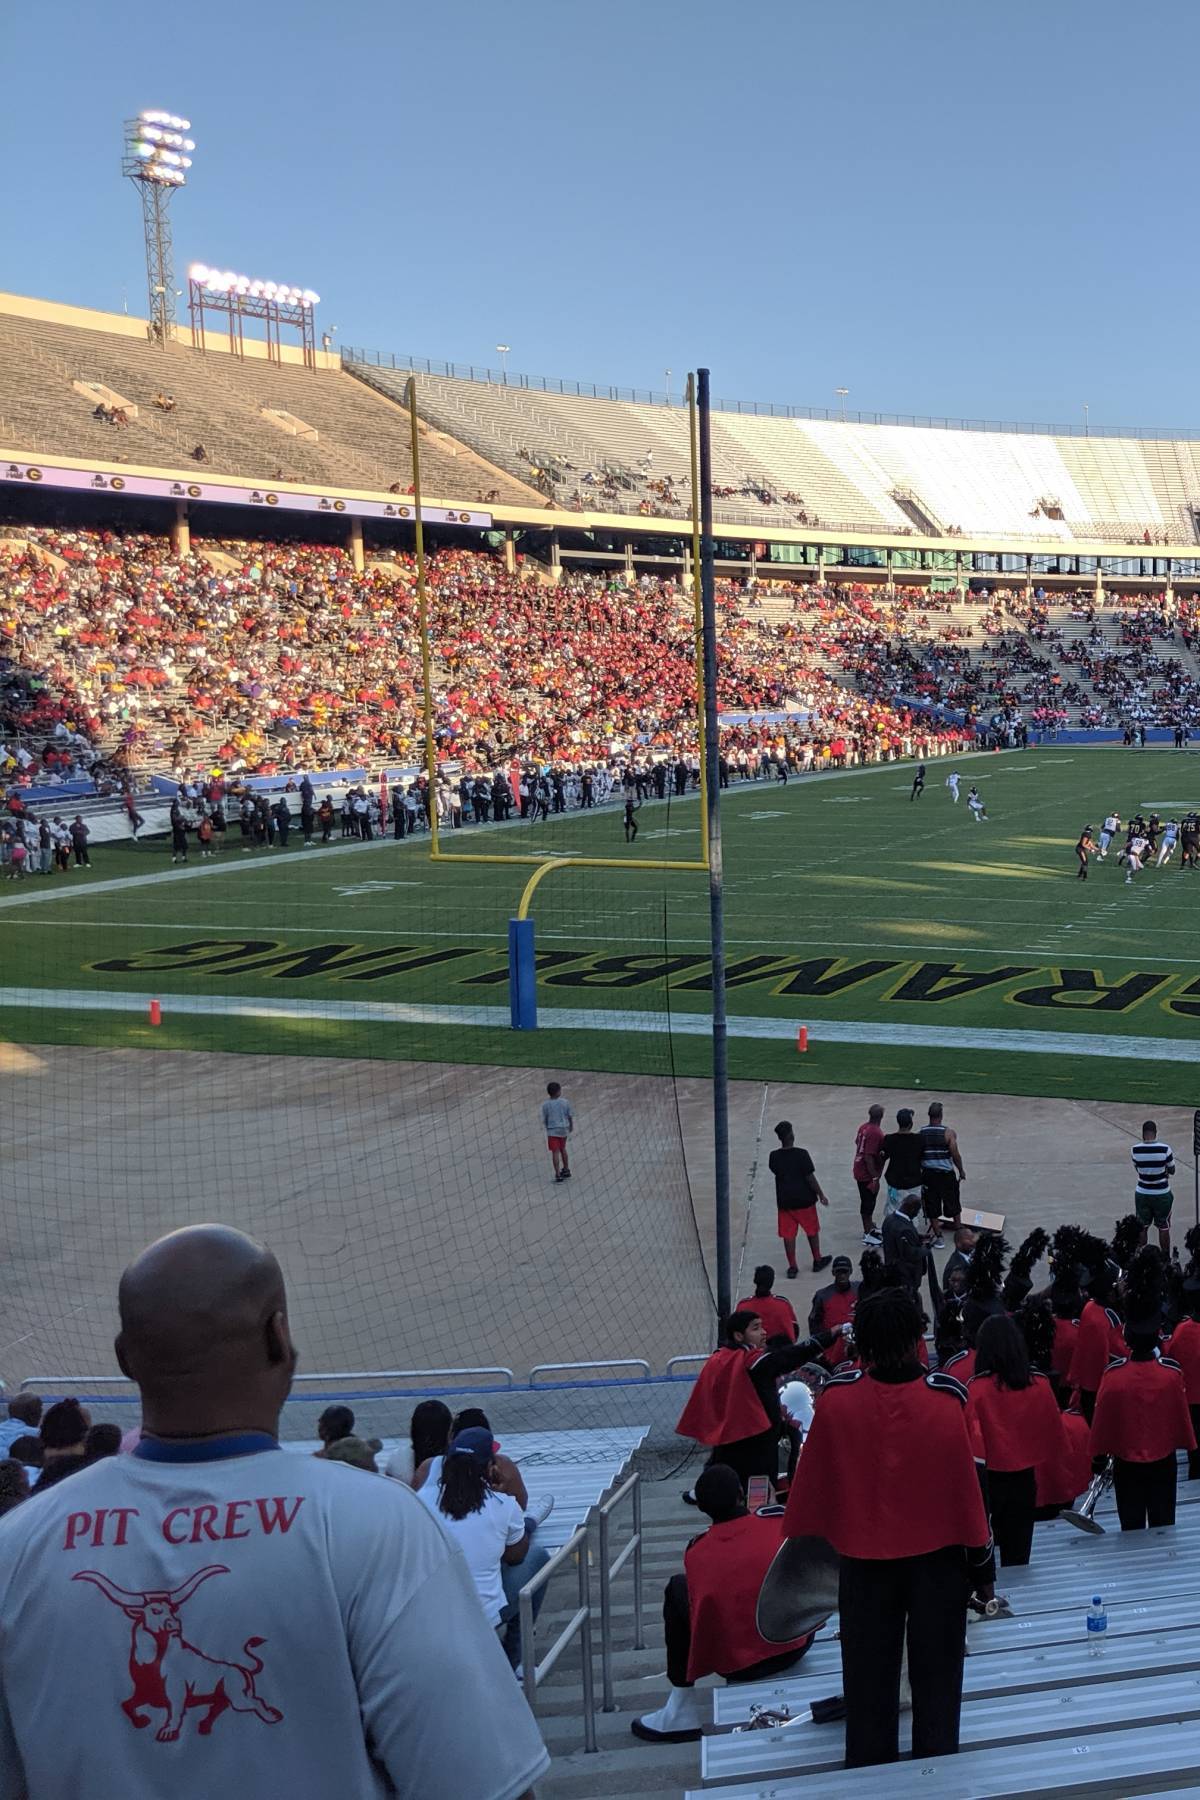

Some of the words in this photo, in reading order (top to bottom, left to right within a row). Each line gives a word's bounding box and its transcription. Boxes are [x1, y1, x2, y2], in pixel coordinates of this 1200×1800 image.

[1130, 823, 1140, 834] 70
[62, 1507, 140, 1552] PIT
[162, 1496, 305, 1546] CREW
